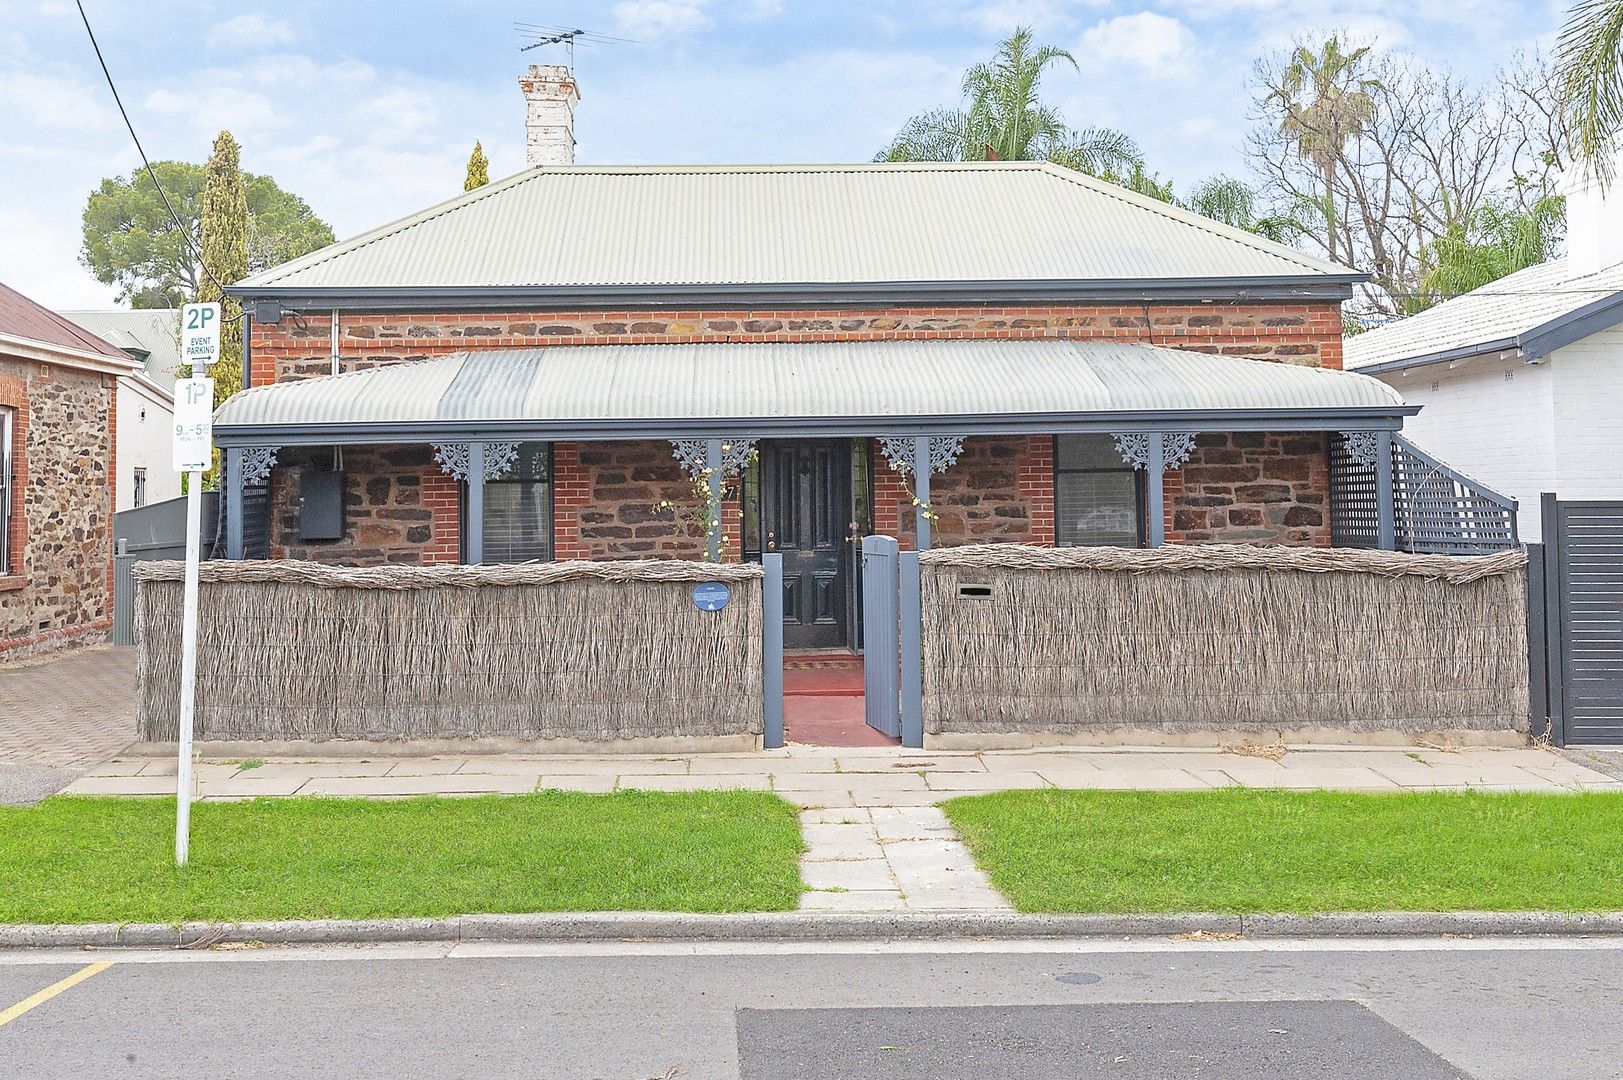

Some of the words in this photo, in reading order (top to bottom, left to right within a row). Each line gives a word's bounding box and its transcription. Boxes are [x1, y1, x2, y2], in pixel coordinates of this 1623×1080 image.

[187, 308, 214, 329] 2P
[191, 336, 211, 346] EVENT
[187, 345, 215, 355] PARKING
[185, 383, 206, 404] 1P
